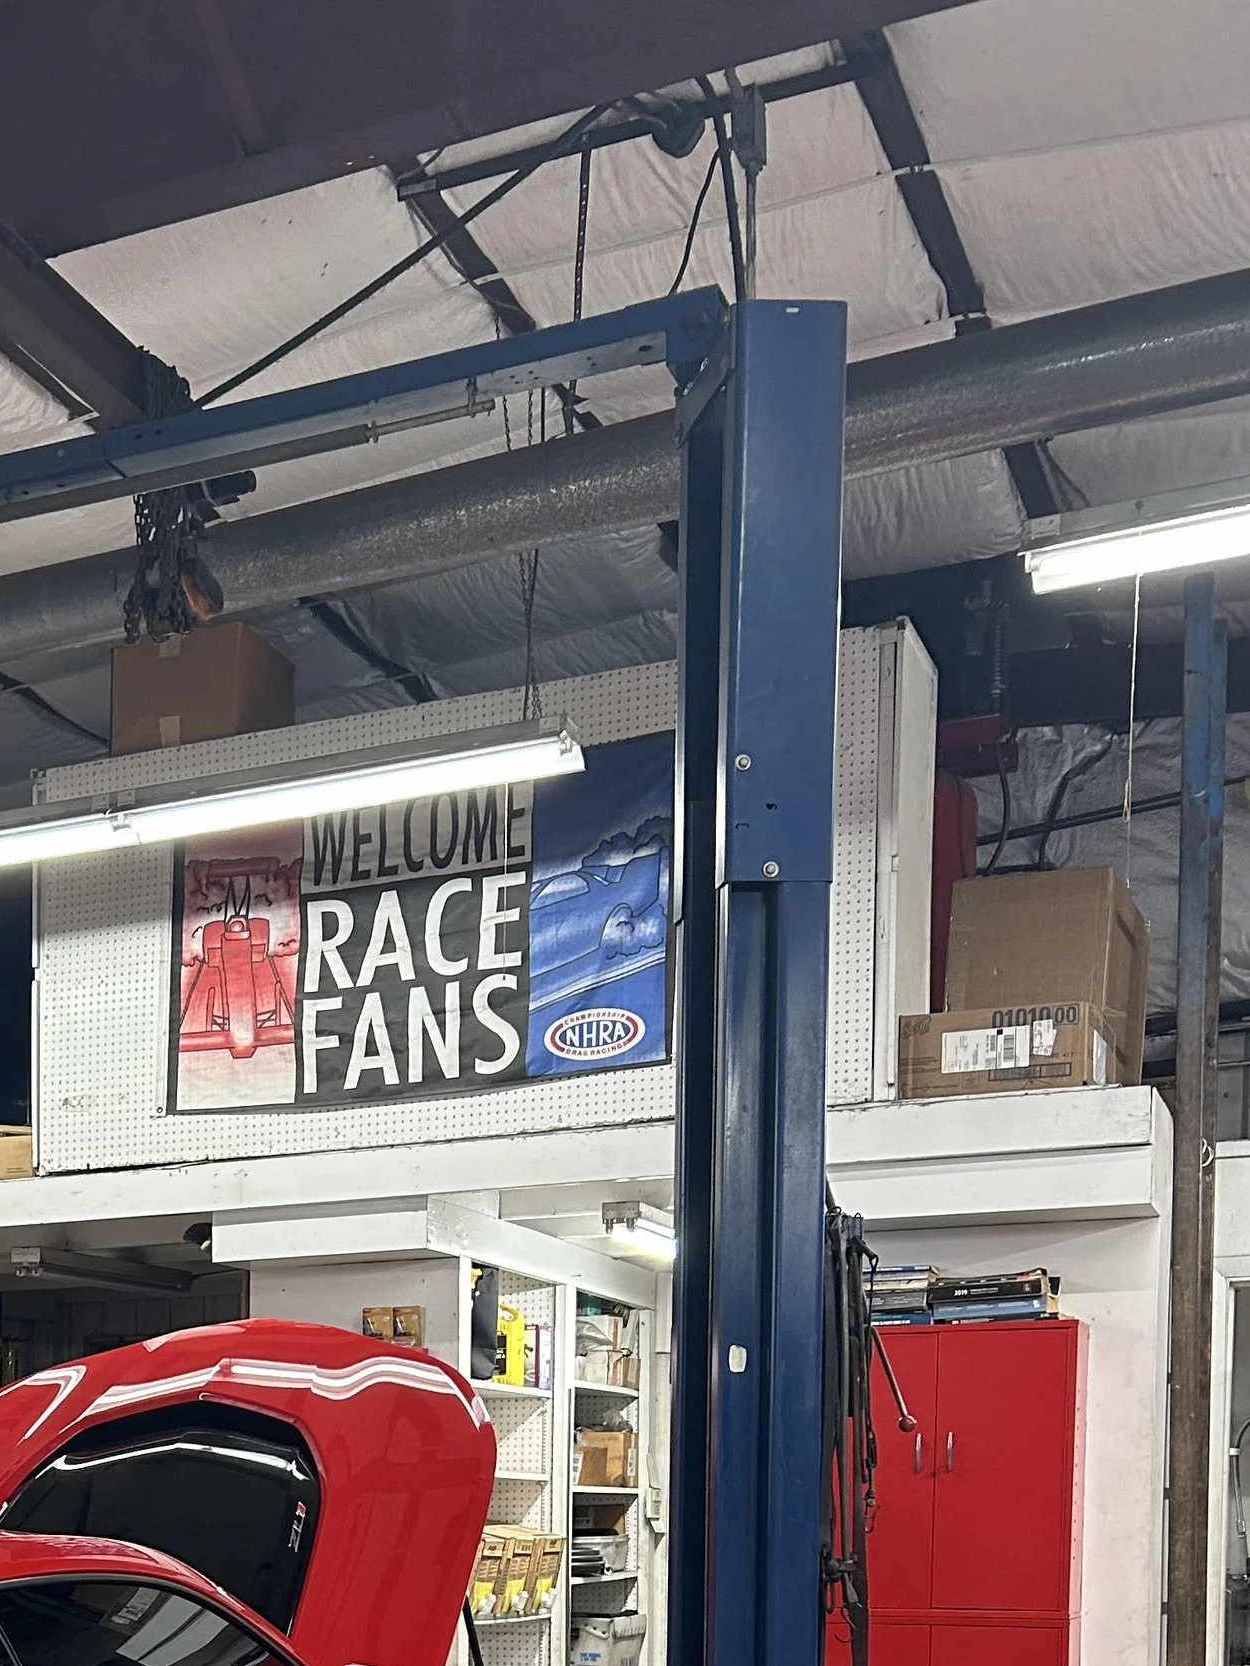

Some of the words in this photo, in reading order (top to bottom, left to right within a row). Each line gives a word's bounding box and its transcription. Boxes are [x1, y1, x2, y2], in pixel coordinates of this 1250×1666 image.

[311, 784, 525, 886] WELCOME
[304, 871, 526, 993] RACE
[302, 974, 520, 1094] FANS
[564, 1011, 626, 1026] CHAMPIONSHIP
[565, 1020, 626, 1048] NHRA
[565, 1047, 588, 1057] DRAG
[590, 1042, 623, 1056] RACING
